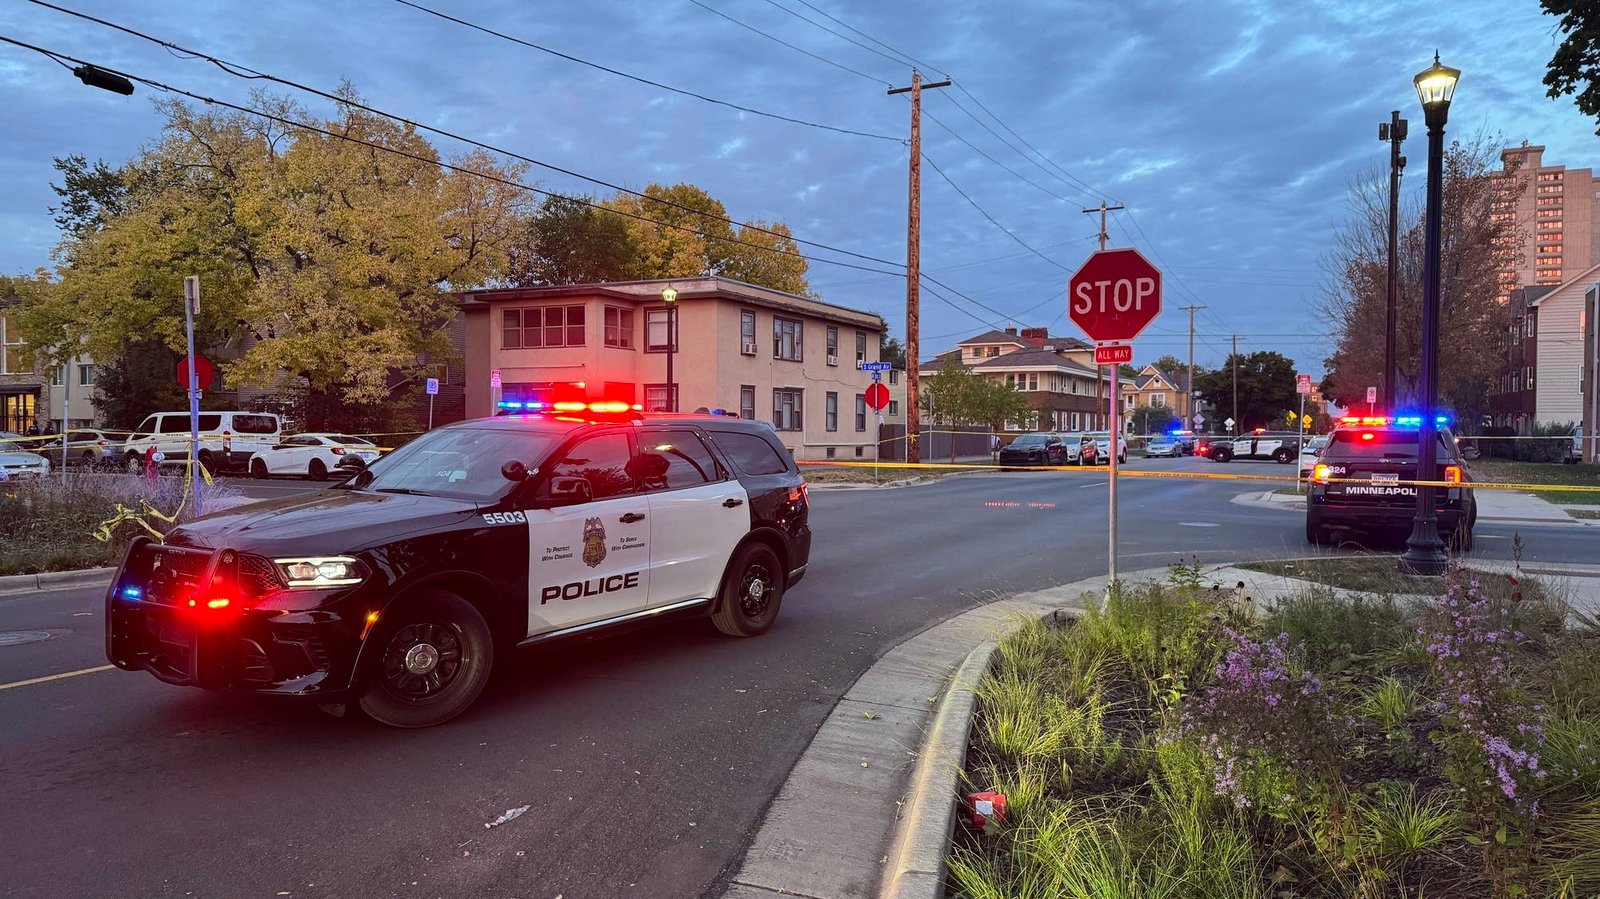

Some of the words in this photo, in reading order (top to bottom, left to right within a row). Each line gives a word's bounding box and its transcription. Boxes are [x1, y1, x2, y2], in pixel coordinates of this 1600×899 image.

[1074, 277, 1155, 315] STOP
[1098, 351, 1111, 360] ALL
[1114, 349, 1130, 359] WAY
[482, 511, 526, 525] 5503
[541, 571, 640, 605] POLICE
